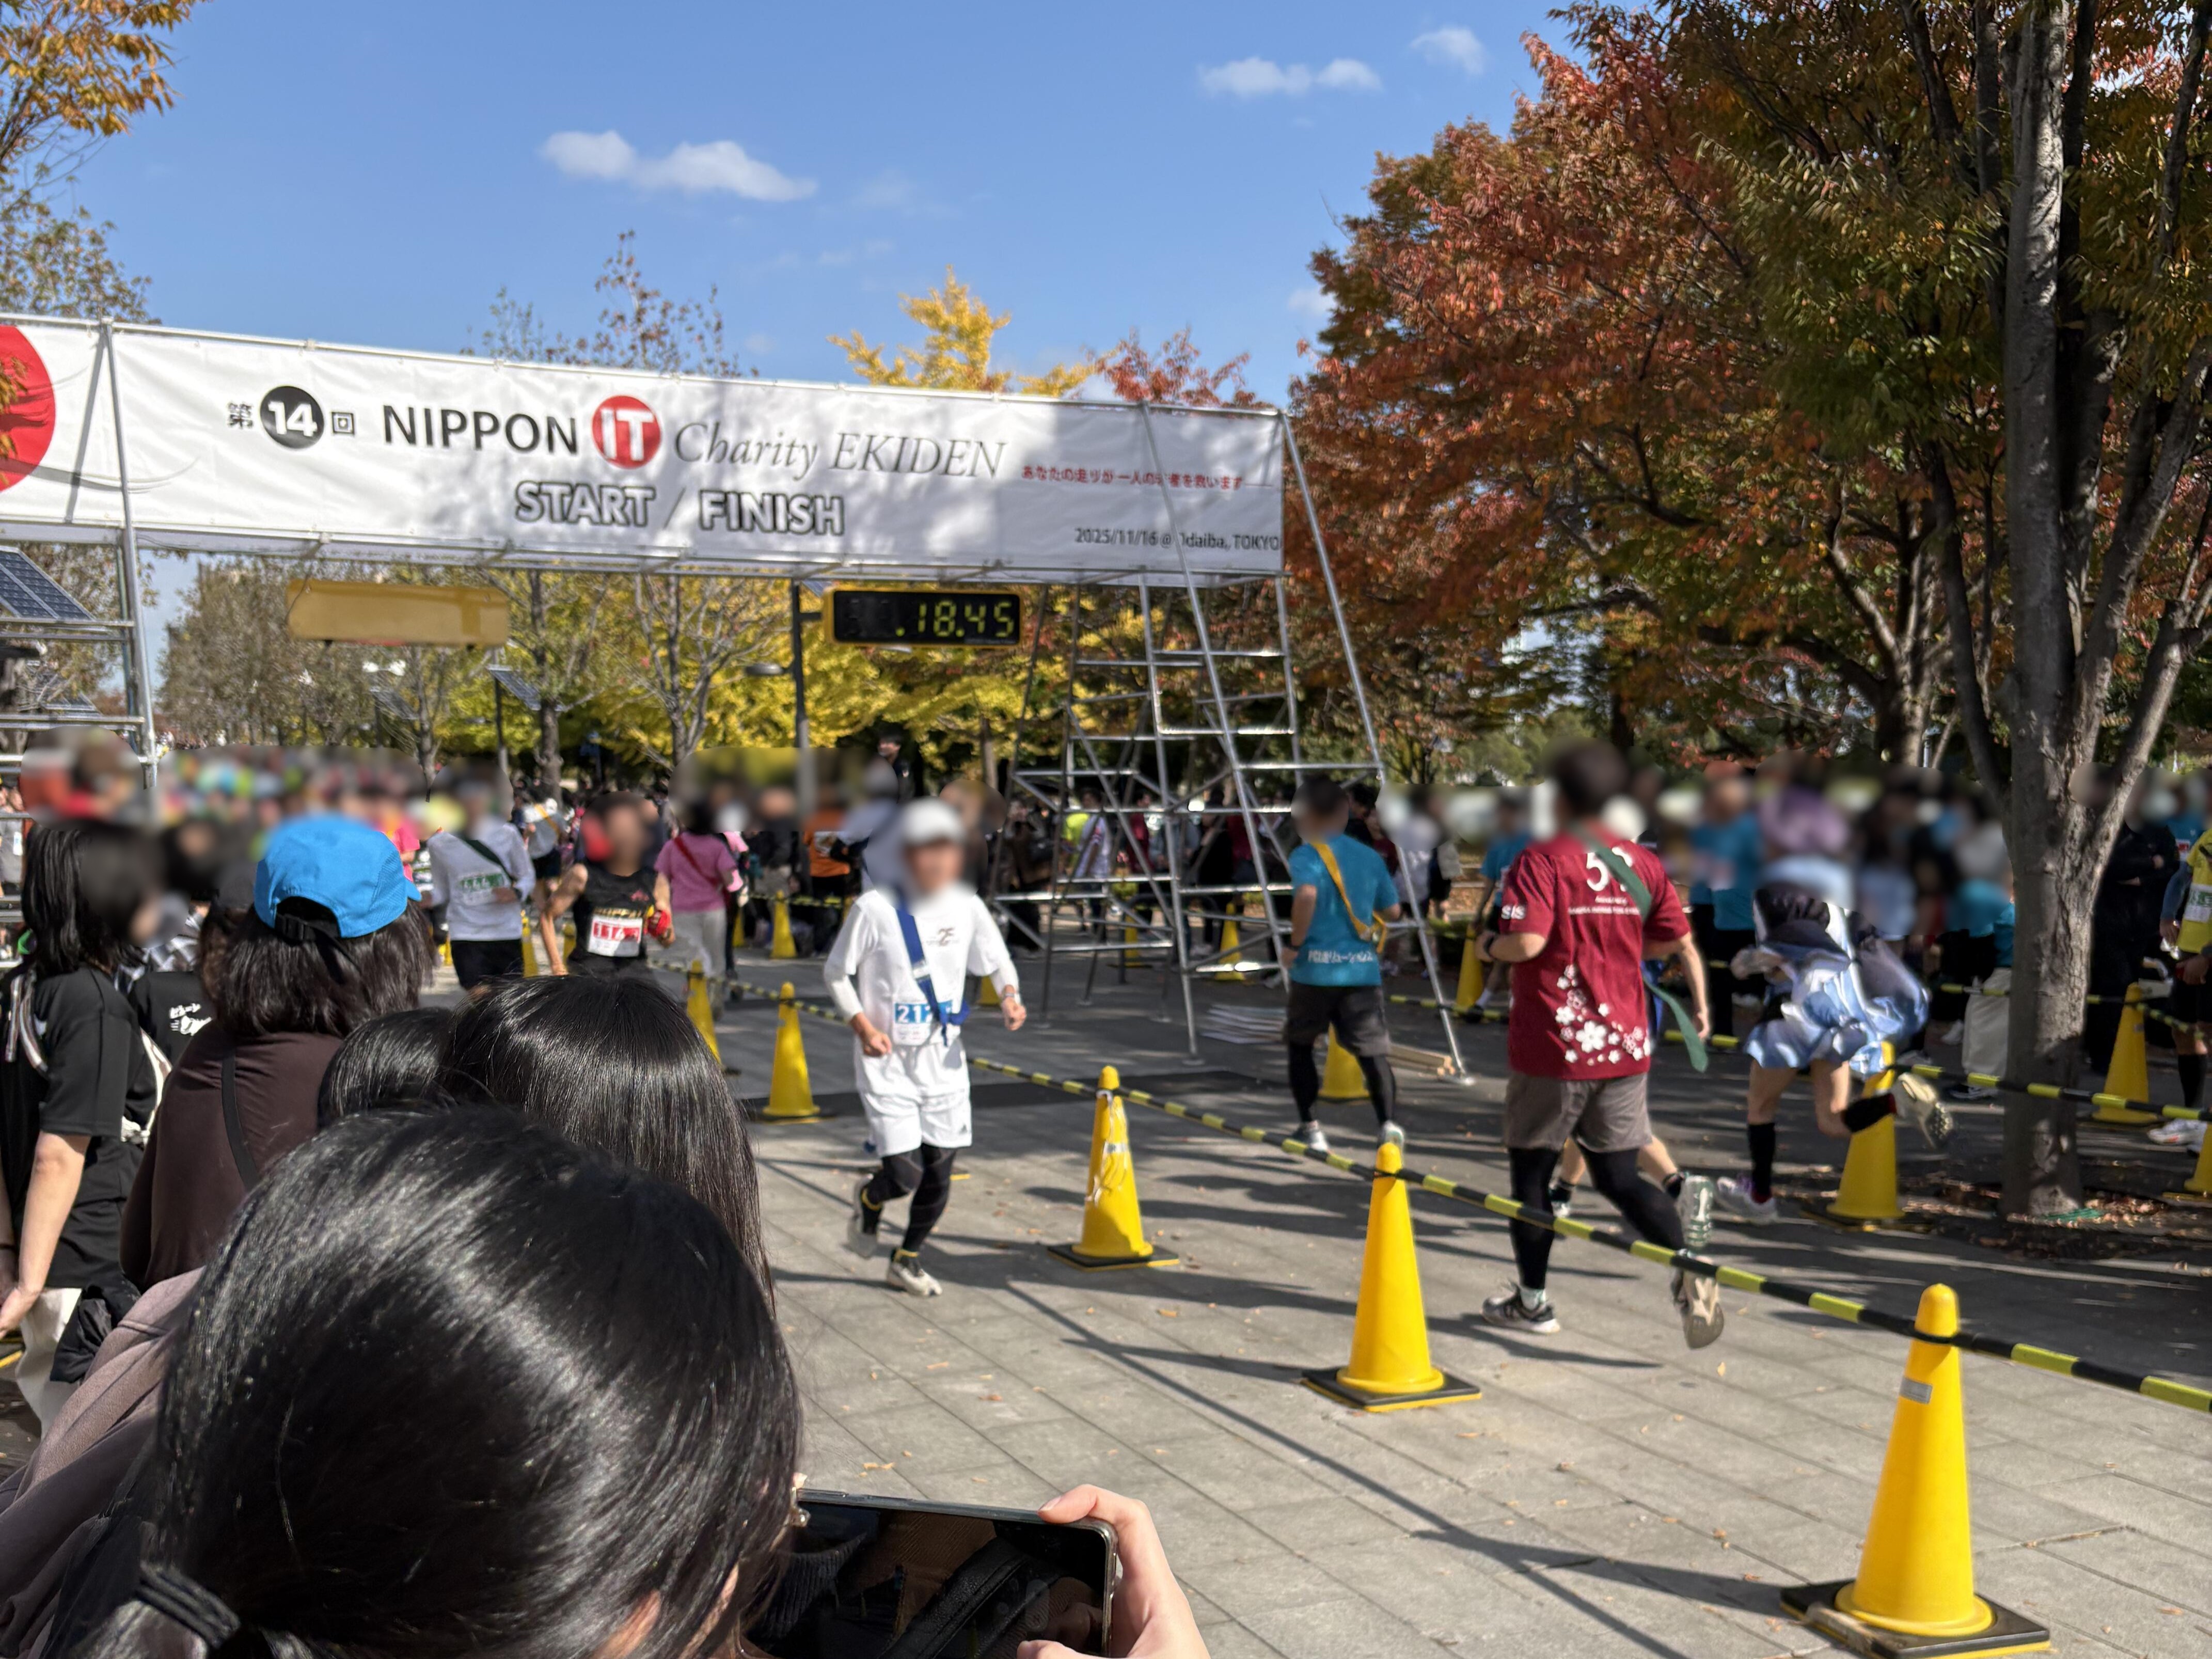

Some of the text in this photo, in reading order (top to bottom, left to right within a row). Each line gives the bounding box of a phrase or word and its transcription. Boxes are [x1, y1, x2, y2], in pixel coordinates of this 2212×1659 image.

[383, 405, 579, 455] NIPPON
[601, 408, 655, 461] IT
[674, 422, 818, 481] Charity
[829, 433, 1008, 479] EKIDEN
[514, 481, 846, 536] START / FINISH
[1075, 528, 1158, 547] 2025/11/16
[1233, 534, 1281, 551] TOKYO
